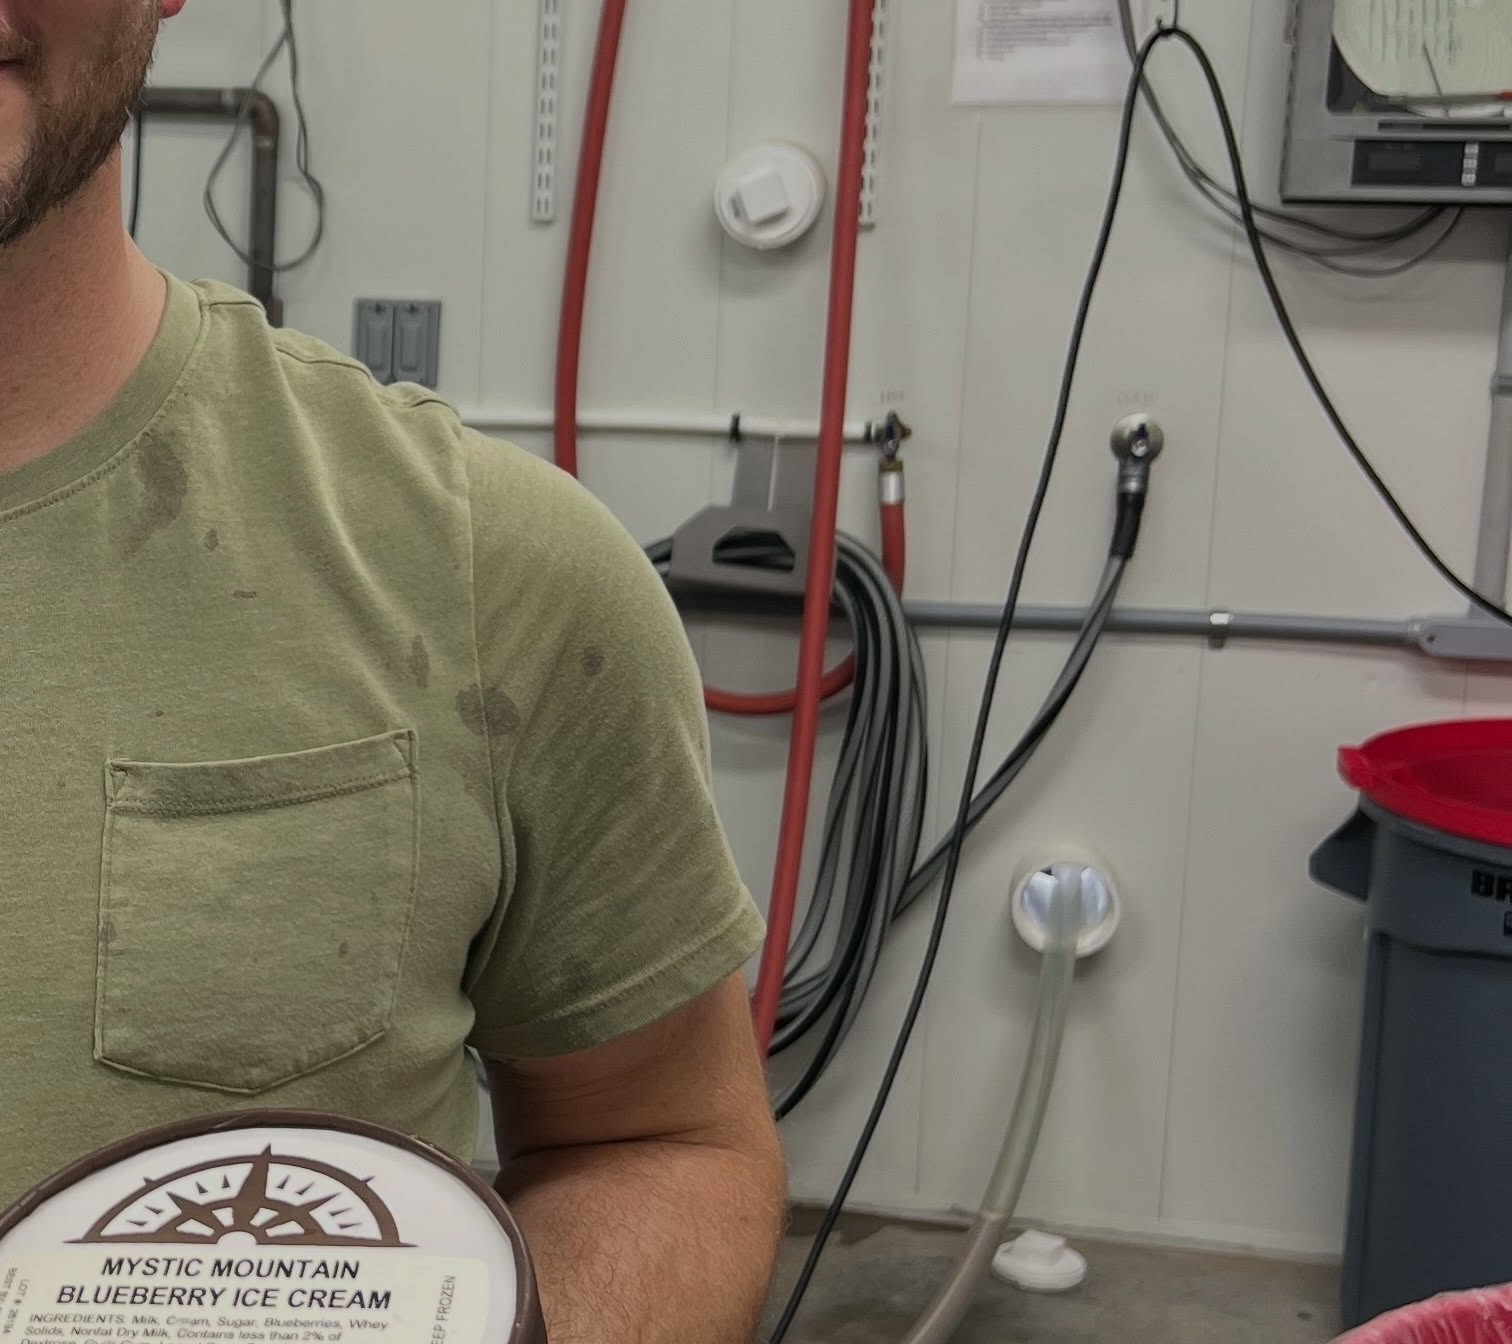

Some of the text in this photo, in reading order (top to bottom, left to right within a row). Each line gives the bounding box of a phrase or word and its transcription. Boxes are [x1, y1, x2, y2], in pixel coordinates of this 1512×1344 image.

[100, 1257, 359, 1278] MYSTIC MOUNTAIN
[56, 1285, 391, 1309] BLUEBERRY ICE CREAM
[436, 1275, 456, 1321] FROZEN
